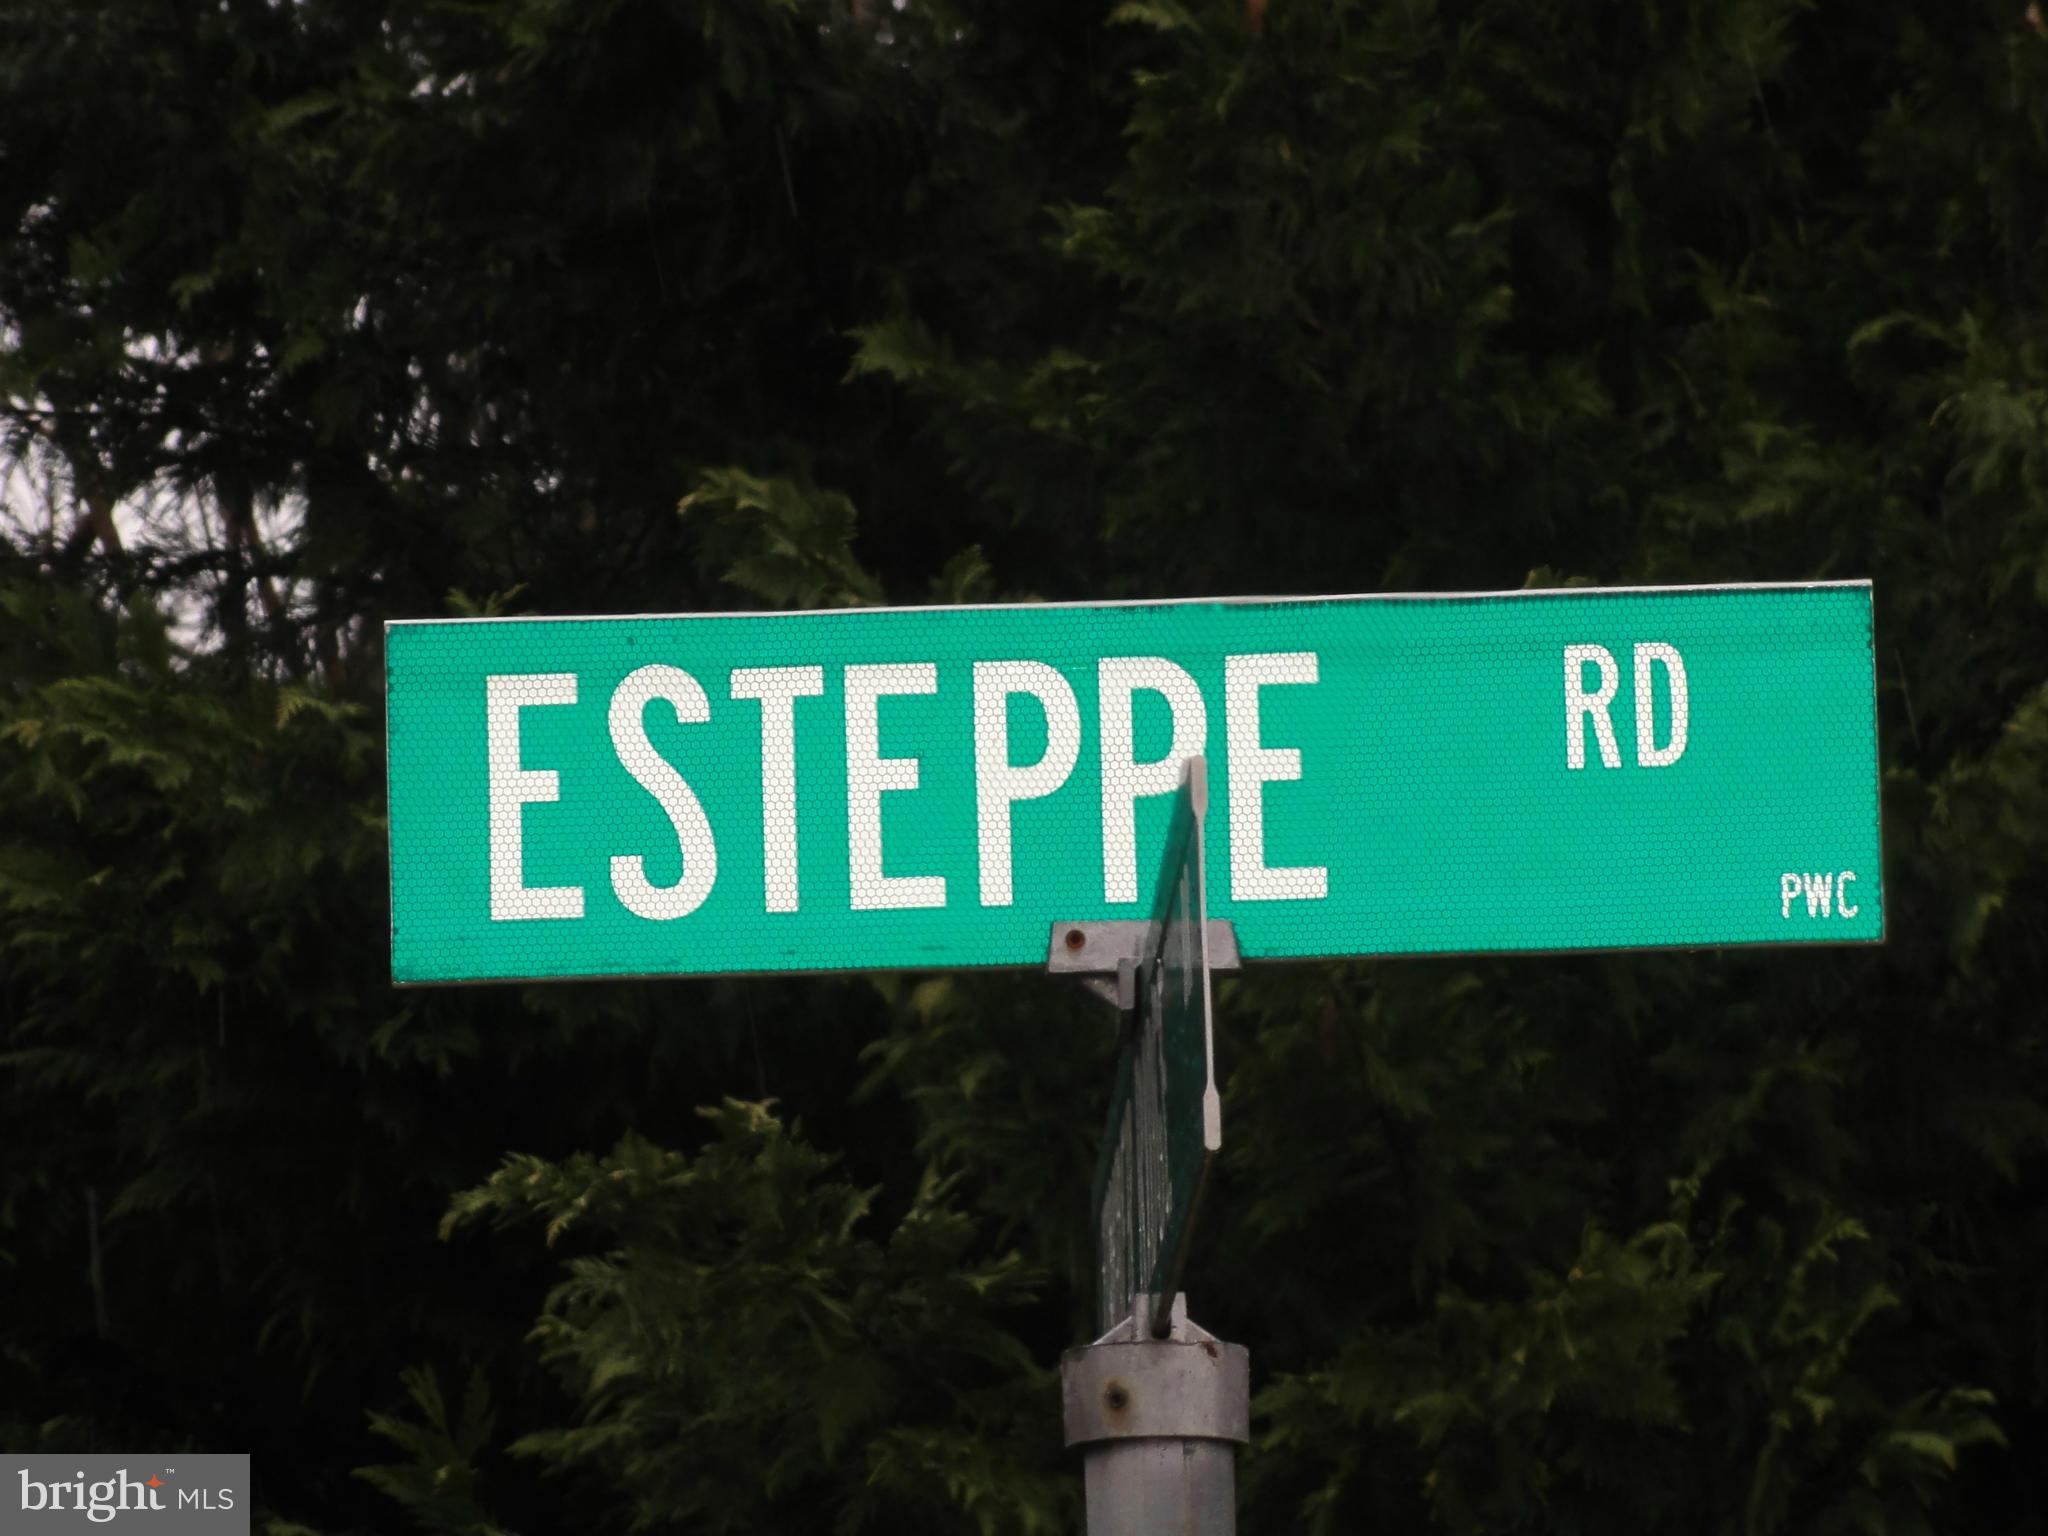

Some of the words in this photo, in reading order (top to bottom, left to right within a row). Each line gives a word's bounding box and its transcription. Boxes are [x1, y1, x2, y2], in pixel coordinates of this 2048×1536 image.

[485, 651, 1329, 922] ESTEPPE
[1563, 641, 1690, 770] RD
[1780, 870, 1859, 919] PWC
